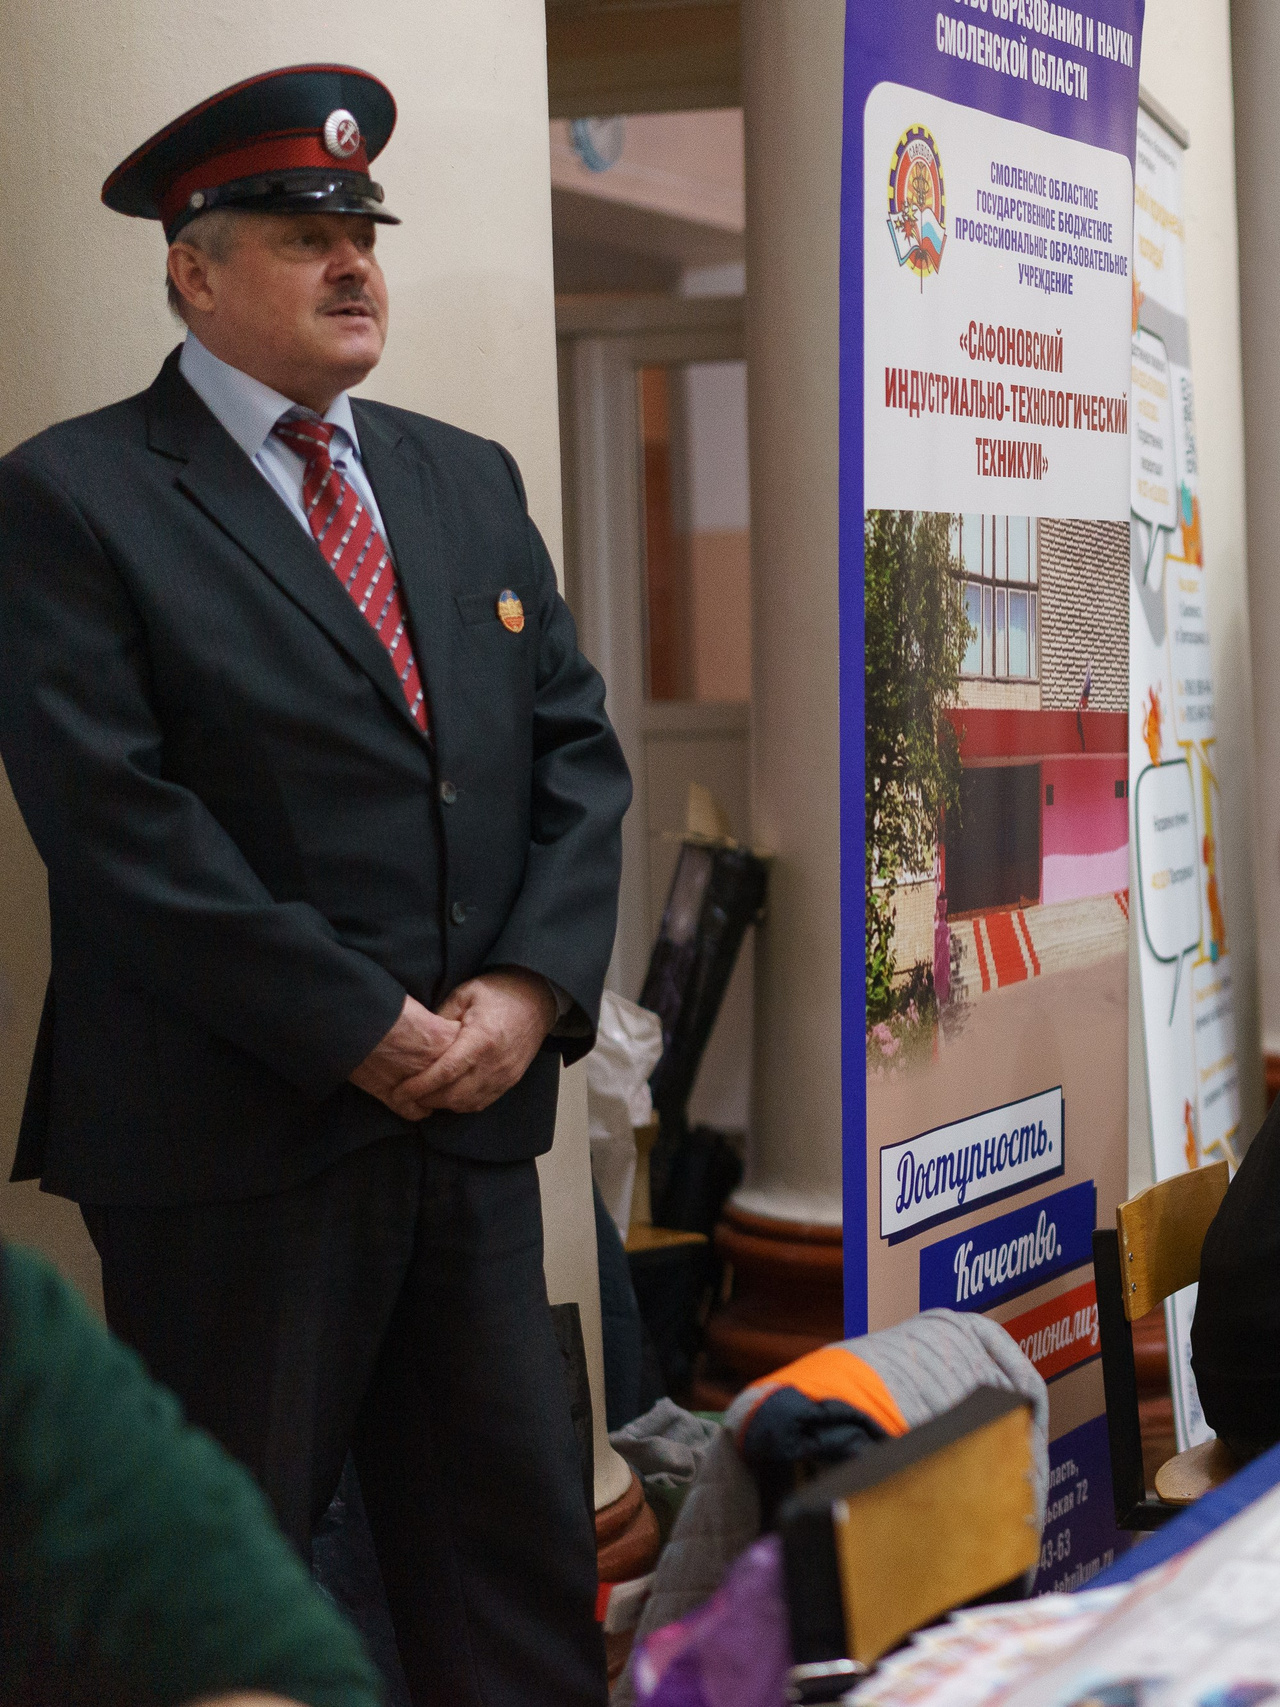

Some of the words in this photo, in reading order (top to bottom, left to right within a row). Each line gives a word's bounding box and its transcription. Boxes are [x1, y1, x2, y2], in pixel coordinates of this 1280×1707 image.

[936, 13, 1028, 80] СМОЛЕНСКОЙ
[1031, 47, 1088, 101] ОБЛАСТИ
[1086, 17, 1094, 53] И
[1098, 21, 1133, 68] НАУКИ
[990, 161, 1047, 198] СМОЛЕНСКОЕ
[1049, 178, 1098, 211] ОБЛАСТНОЕ
[976, 189, 1056, 231] ГОСУДАРСТВЕННОЕ
[1058, 211, 1113, 244] БЮДЖЕТНОЕ
[955, 217, 1048, 260] ПРОФЕССИОНАЛЬНОЕ
[1050, 239, 1128, 277] ОБРАЗОВАТЕЛЬНОЕ
[1018, 262, 1074, 295] УЧРЕЖДЕНИЕ
[959, 320, 1064, 374] «САФОНОВСКИЙ
[884, 366, 1128, 435] ИНДУСТРИАЛЬНО-ТЕХНОЛОГИЧЕСКИЙ
[975, 437, 1049, 480] ТЕХНИКУМ»
[895, 1119, 1053, 1214] Доступность.
[954, 1209, 1063, 1303] Качество.
[1076, 1479, 1088, 1505] 72
